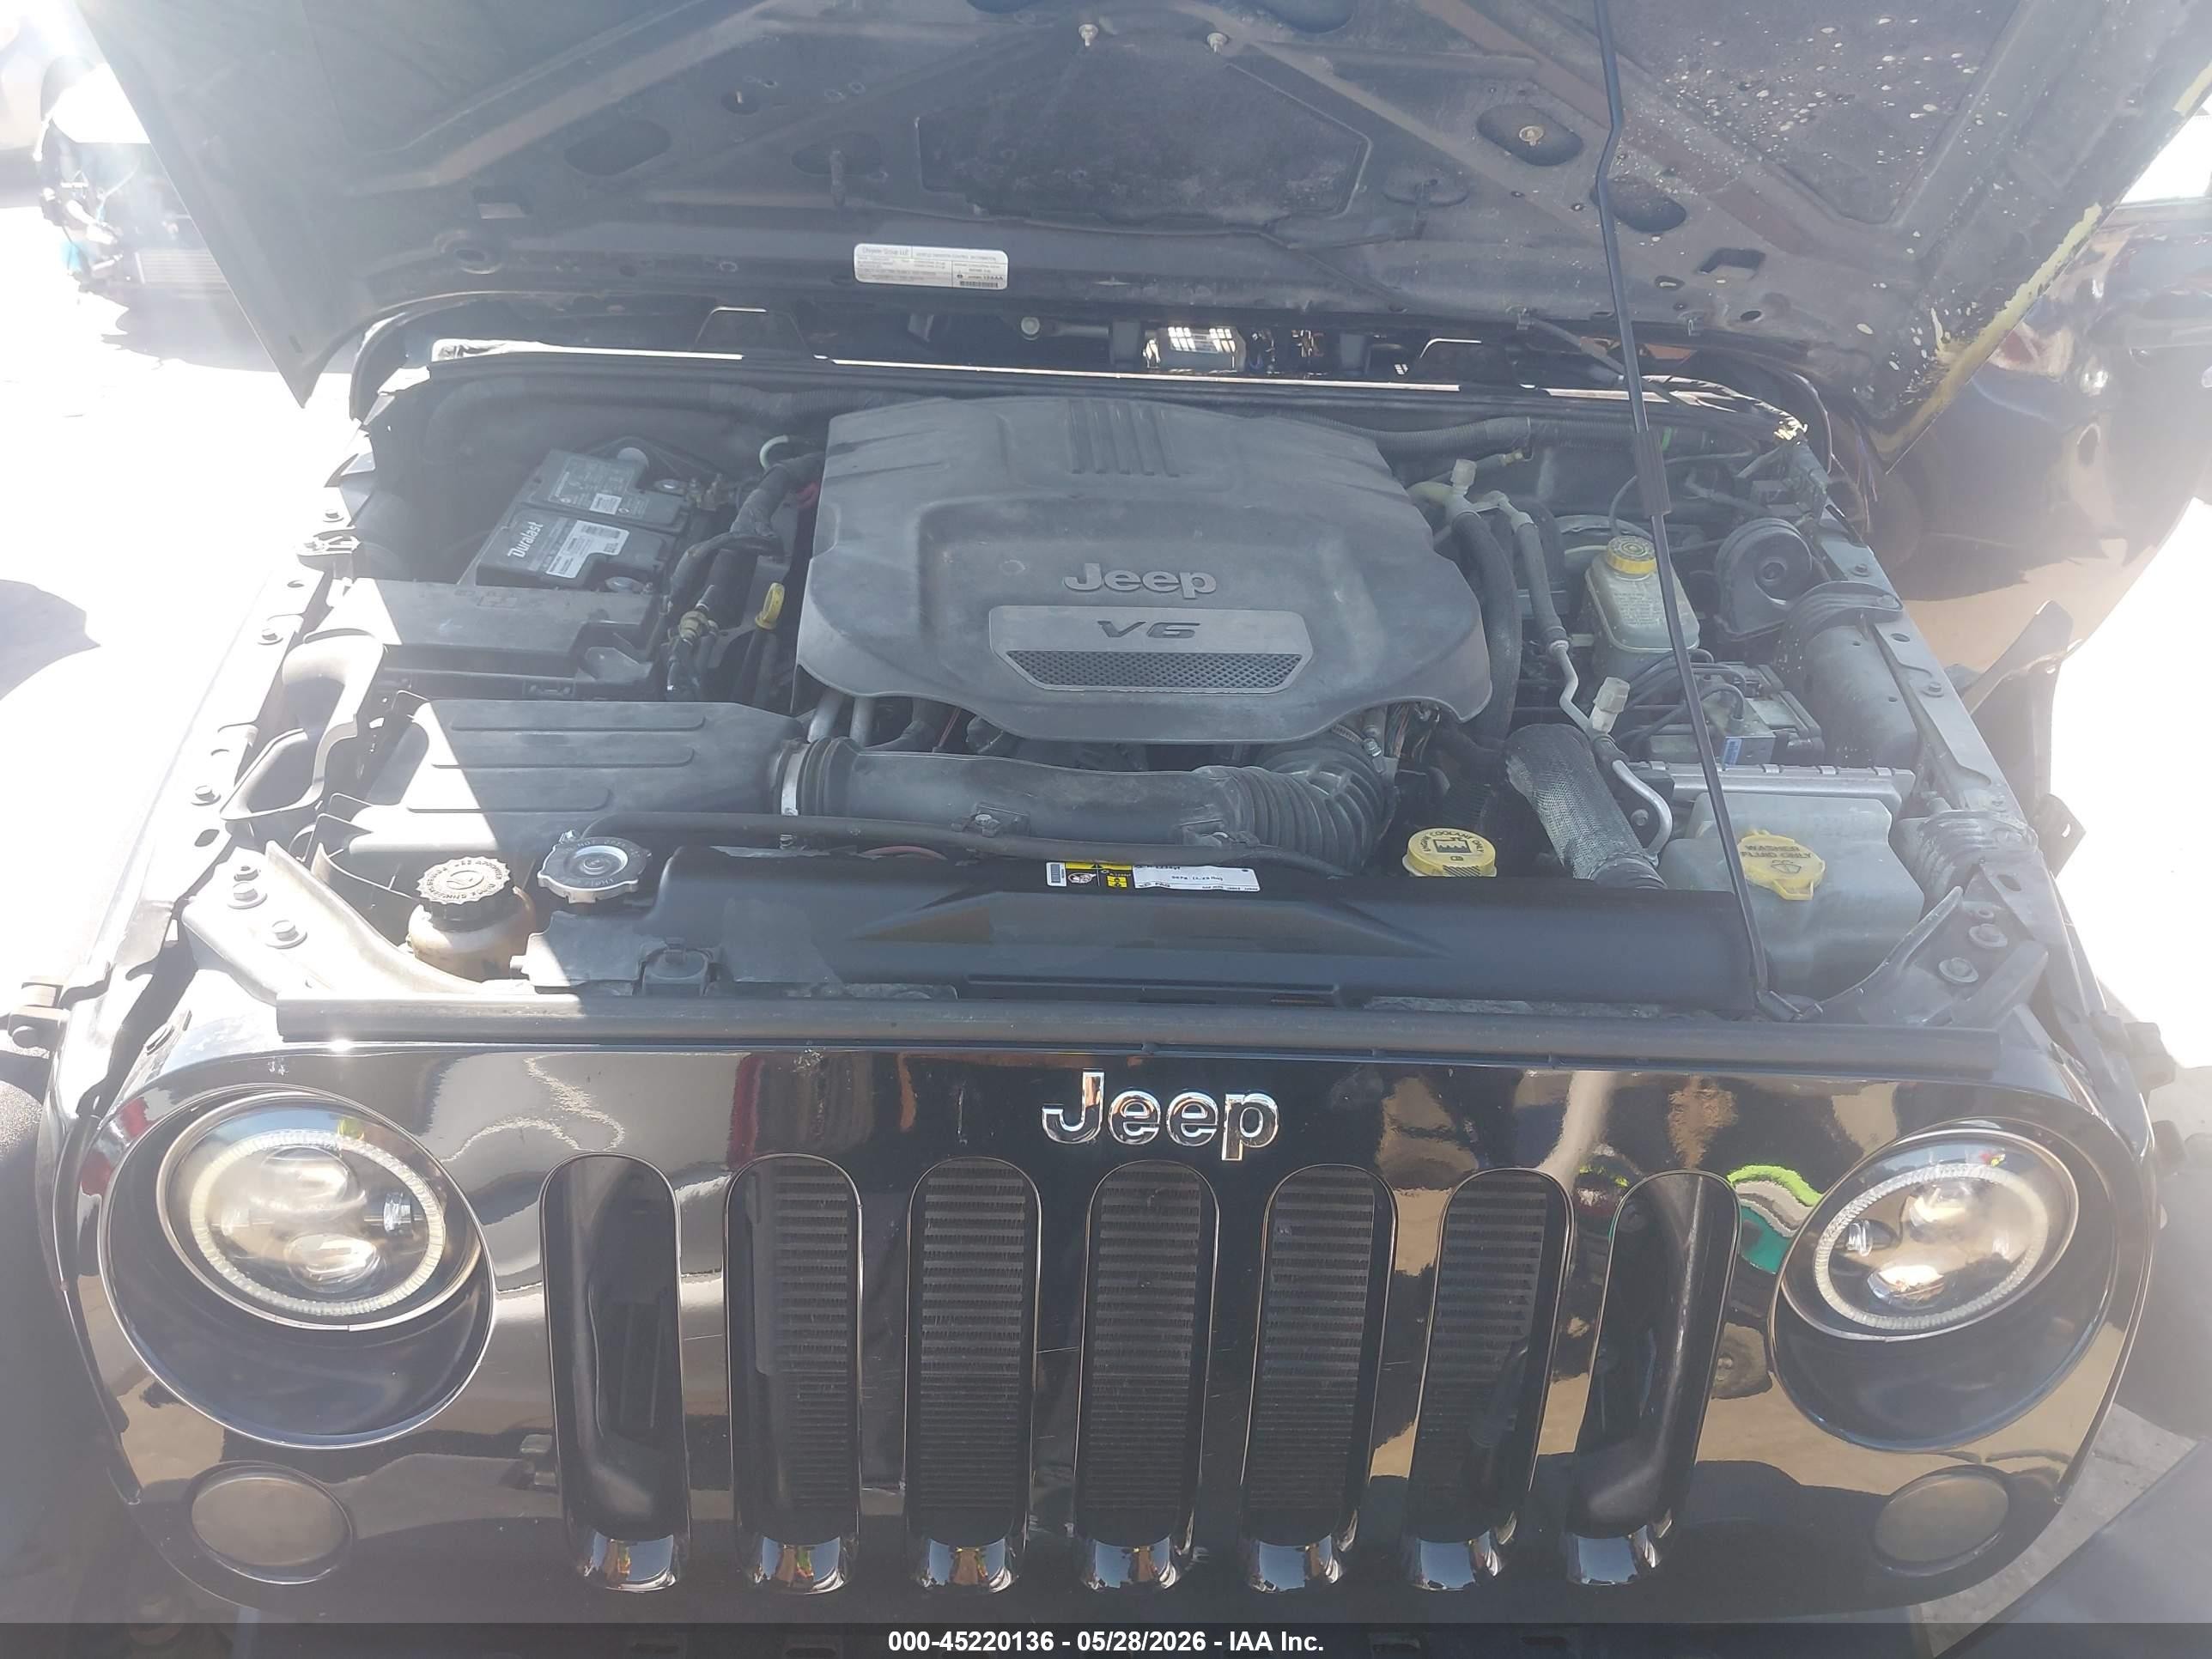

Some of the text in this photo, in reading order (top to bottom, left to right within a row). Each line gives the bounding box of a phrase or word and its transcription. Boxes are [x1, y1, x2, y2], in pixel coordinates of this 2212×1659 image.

[507, 521, 544, 558] Duralast
[1063, 563, 1217, 599] Jeep
[1097, 620, 1200, 639] V6
[1041, 1071, 1279, 1161] Jeep
